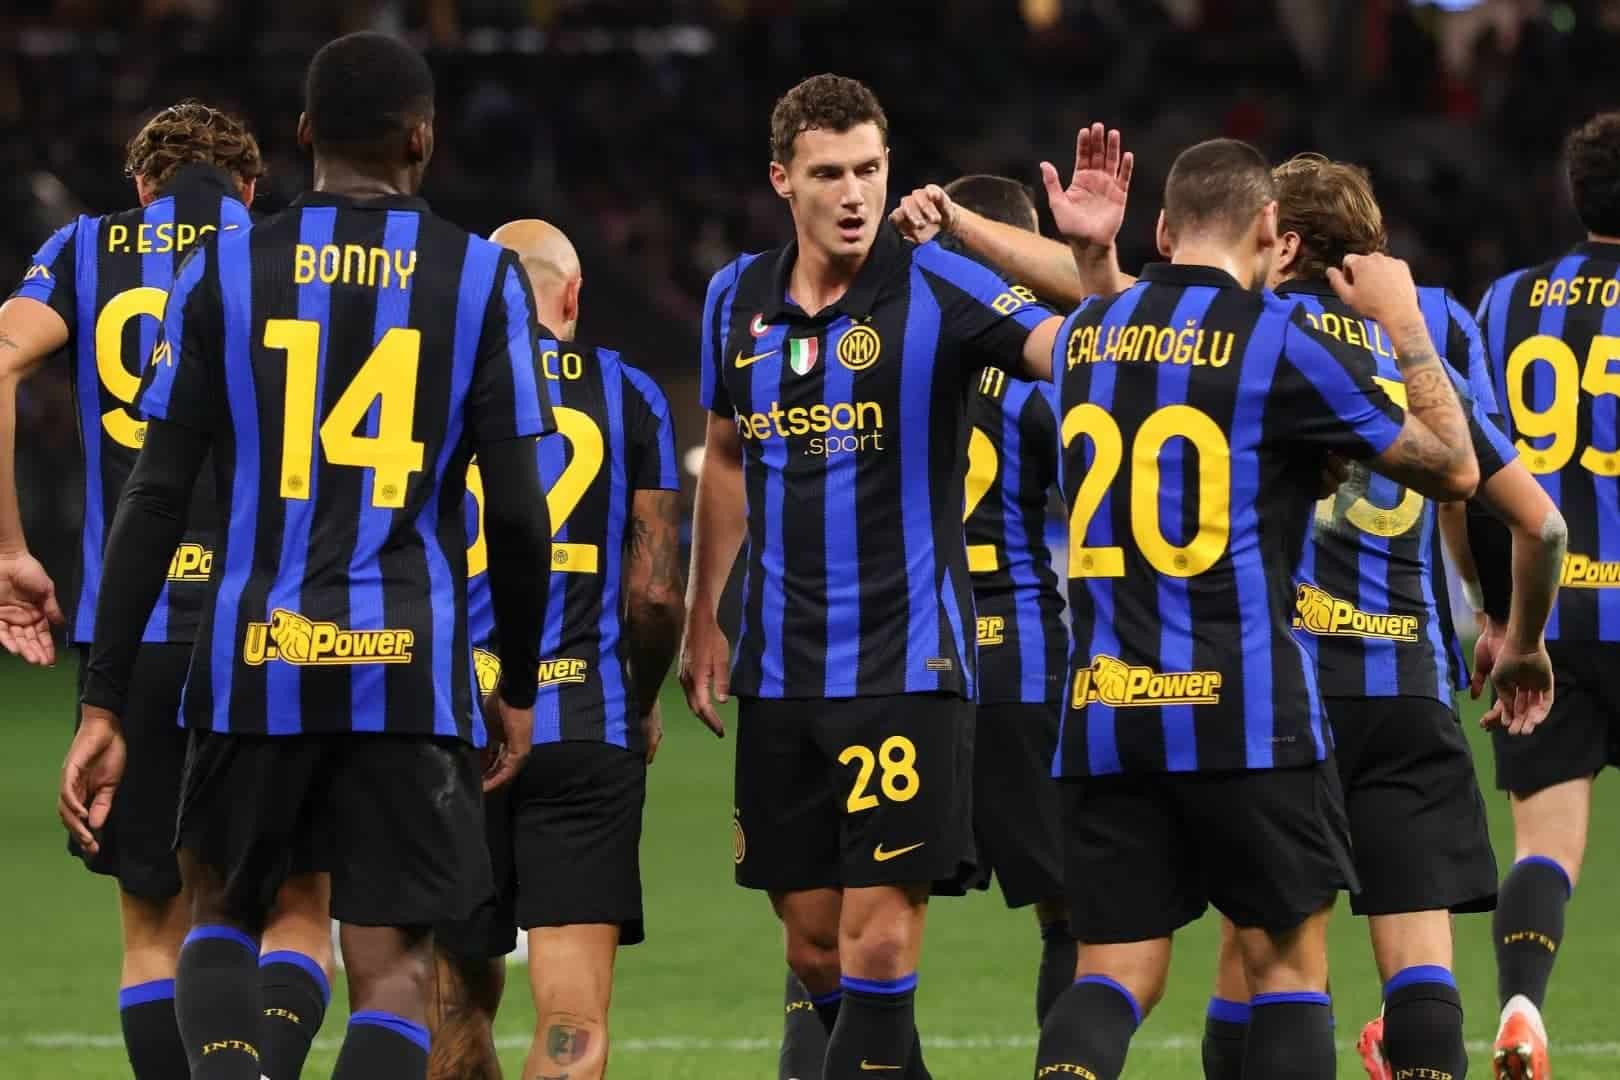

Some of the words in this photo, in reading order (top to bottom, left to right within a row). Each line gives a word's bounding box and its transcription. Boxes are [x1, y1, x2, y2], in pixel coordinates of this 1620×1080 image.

[294, 244, 416, 289] BONNY
[1529, 277, 1620, 307] BASTO
[263, 319, 424, 508] 14
[1507, 334, 1620, 476] 95
[1060, 403, 1231, 579] 20
[1566, 555, 1620, 584] Pow
[538, 660, 586, 683] wer
[838, 736, 920, 813] 28
[1504, 931, 1555, 952] INTER
[264, 1008, 300, 1024] TER
[786, 1001, 813, 1014] INT
[203, 1040, 259, 1061] INTER
